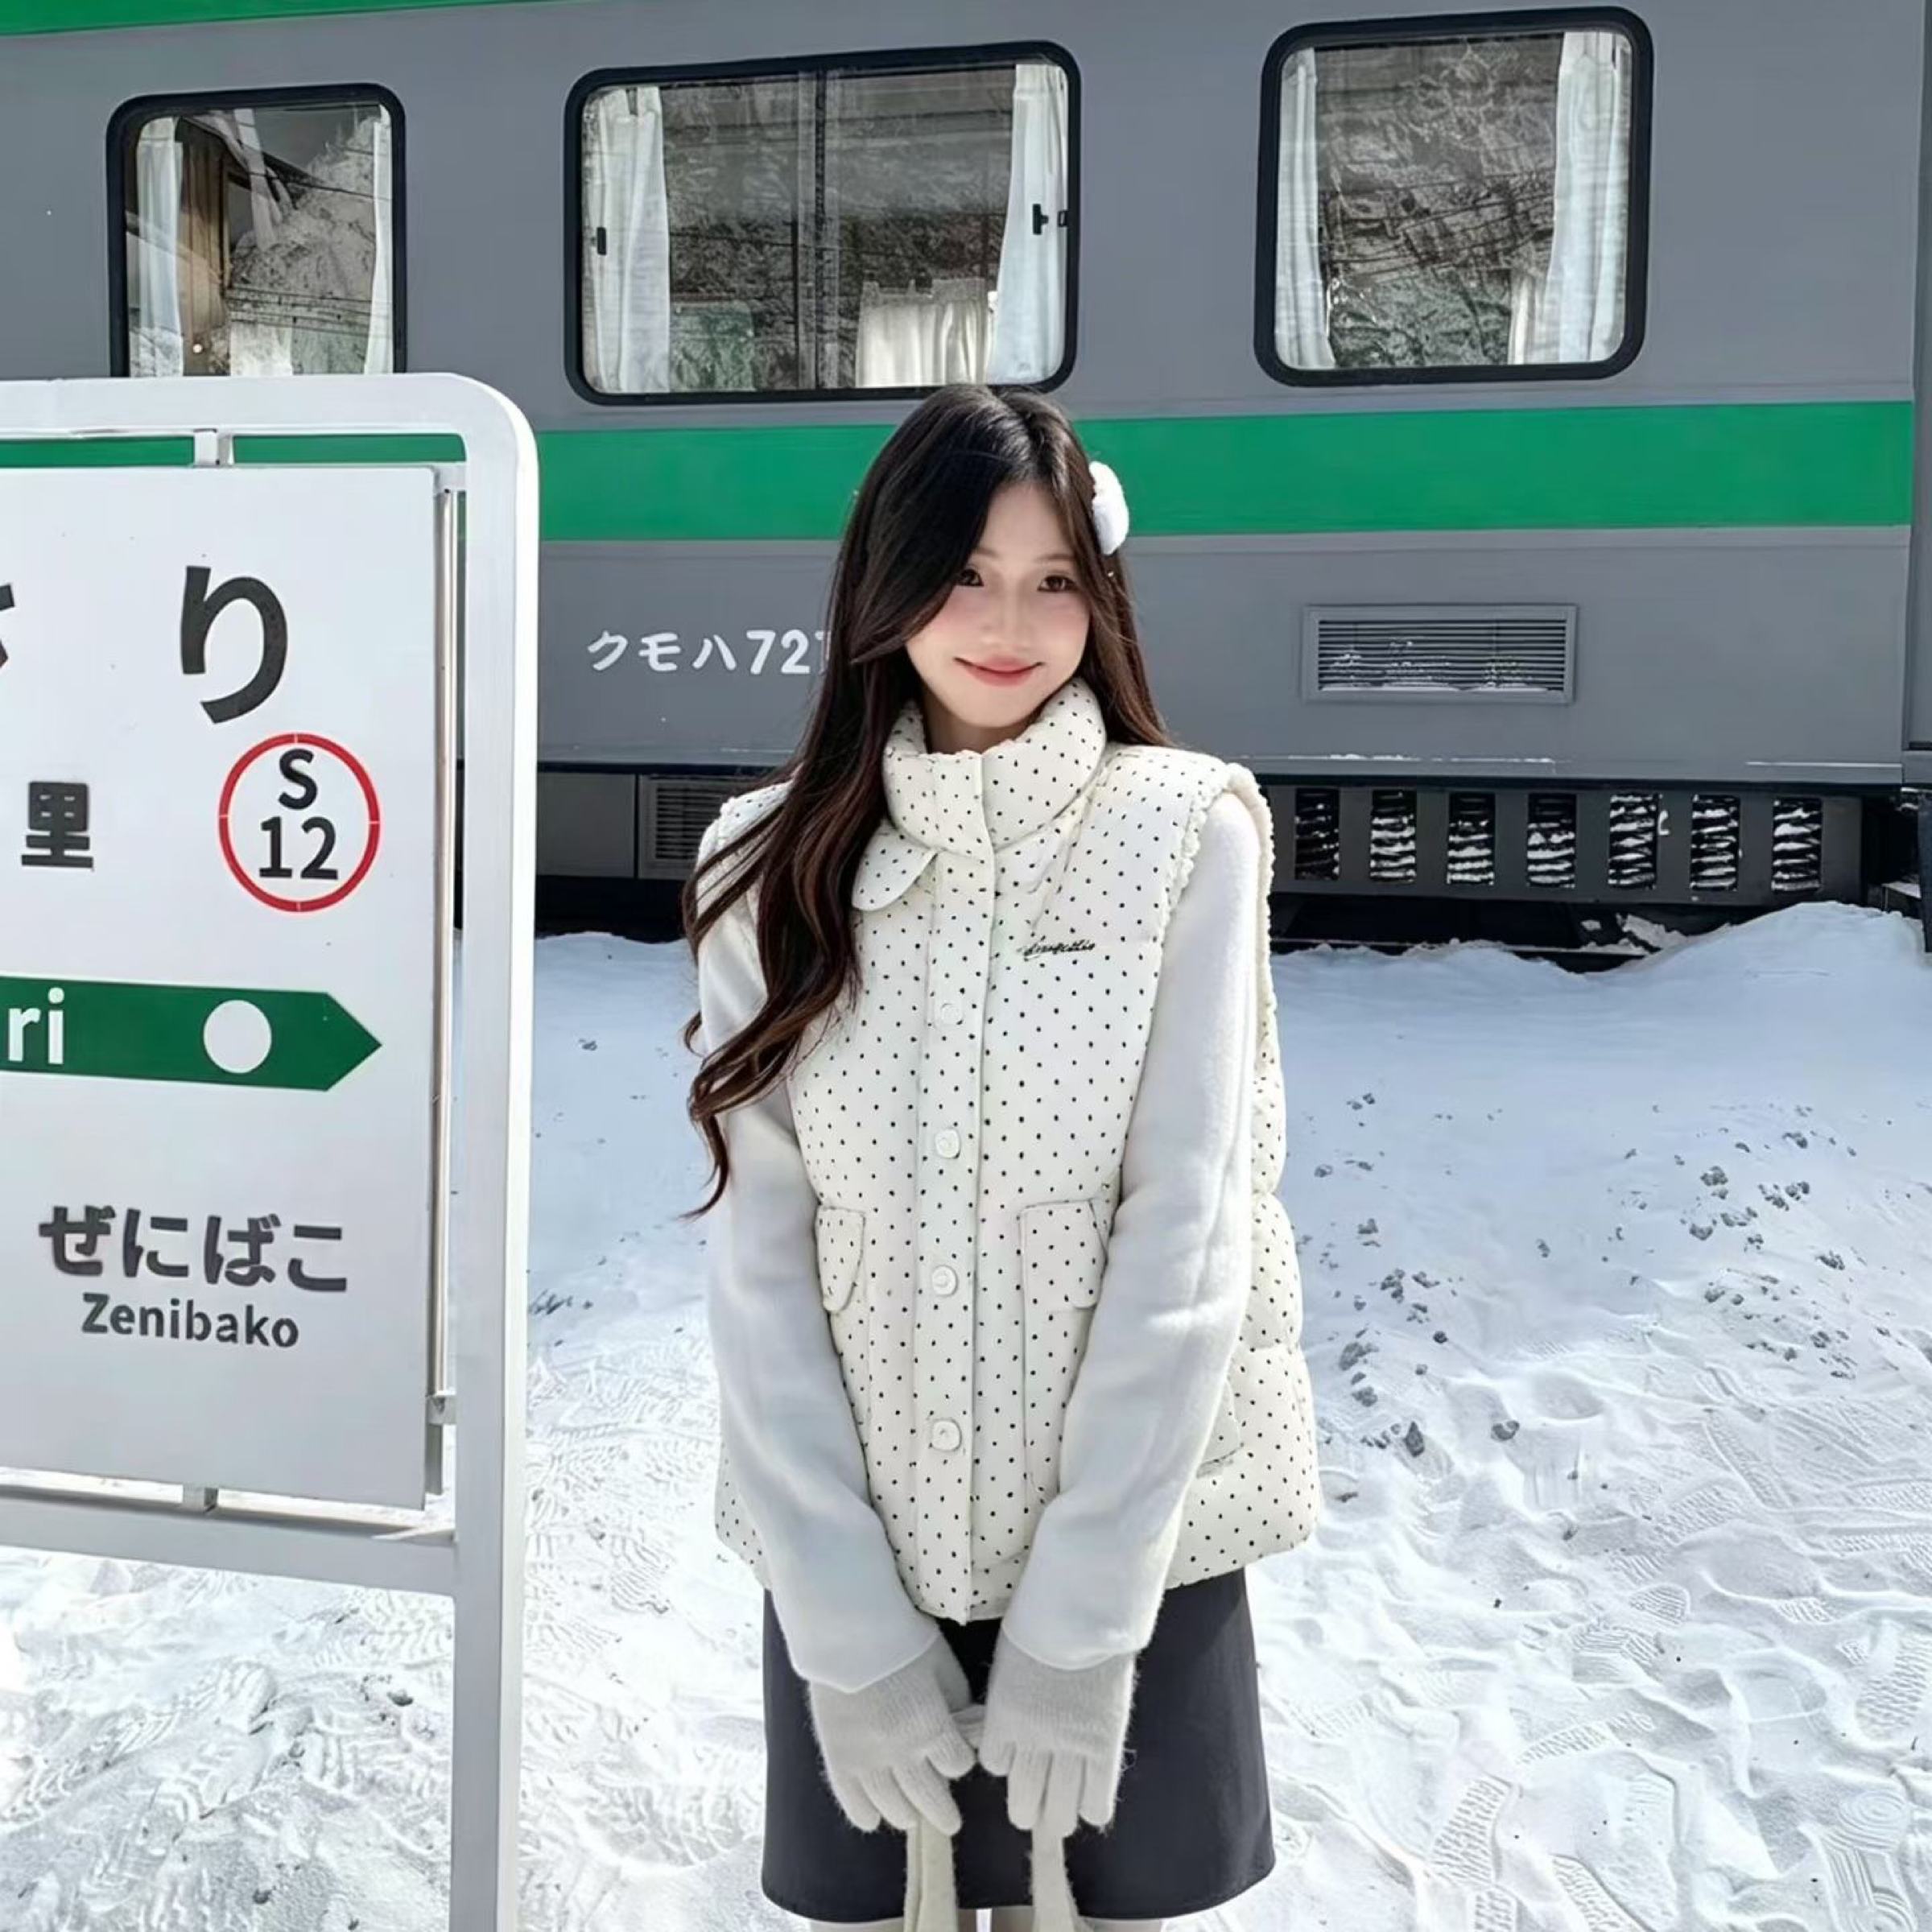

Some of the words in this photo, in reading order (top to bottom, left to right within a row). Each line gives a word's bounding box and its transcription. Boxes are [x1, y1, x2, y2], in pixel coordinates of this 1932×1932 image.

[278, 748, 318, 810] S
[21, 781, 93, 869] 里
[258, 816, 339, 880] 12
[7, 987, 64, 1064] ri
[38, 1205, 347, 1292] ぜにばこ
[81, 1292, 299, 1348] Zenibako
